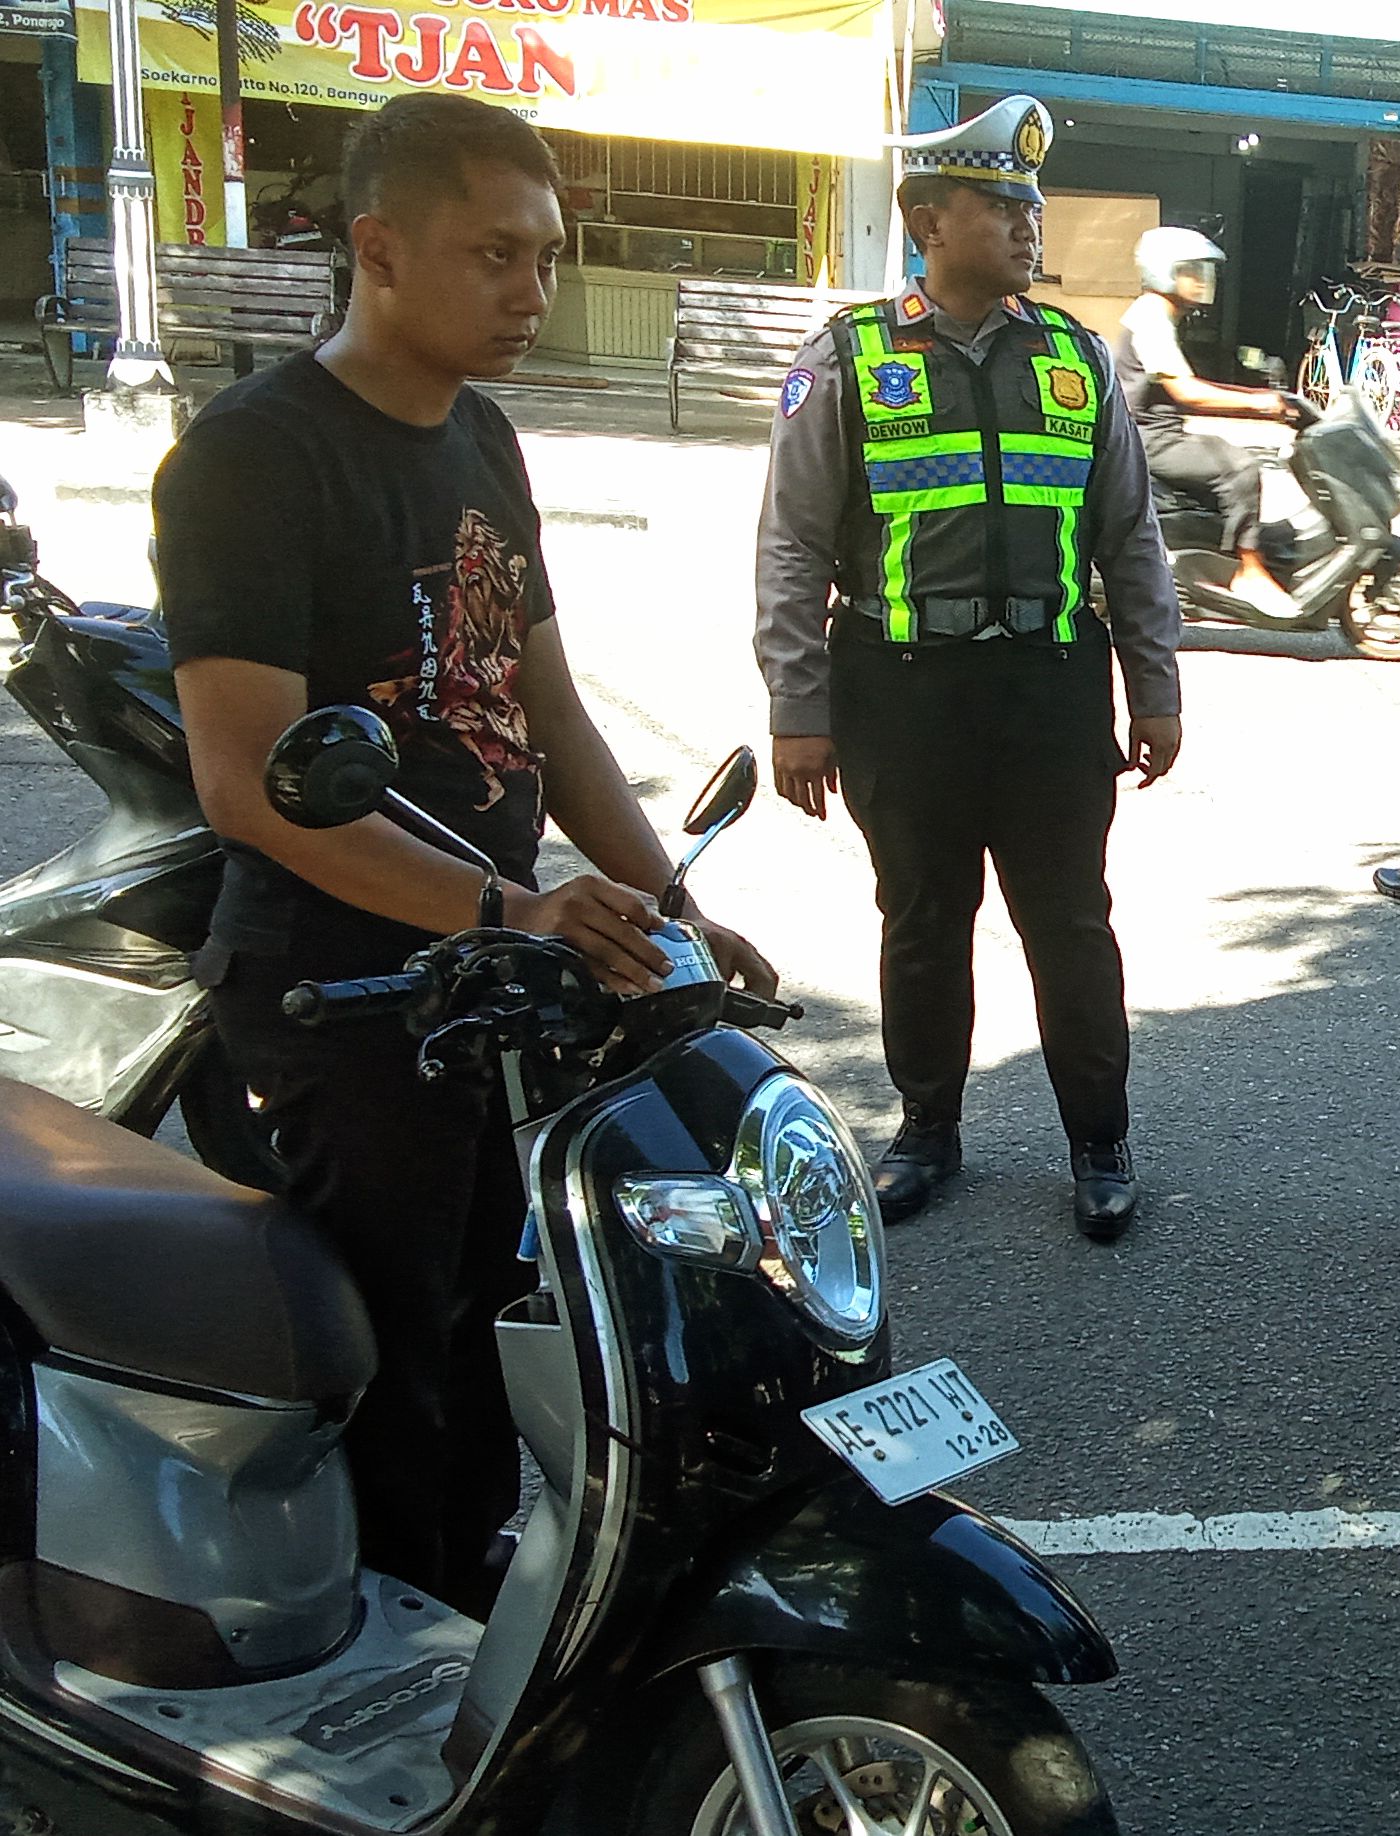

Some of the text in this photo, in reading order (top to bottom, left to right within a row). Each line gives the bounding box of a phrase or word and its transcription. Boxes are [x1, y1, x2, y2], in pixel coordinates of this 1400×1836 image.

[141, 68, 390, 104] Soekarno tta No.120, Bangun
[803, 156, 821, 287] JAND
[869, 420, 927, 438] DEWOW
[1049, 419, 1090, 438] KASAT
[824, 1370, 978, 1455] AE 2721 WT
